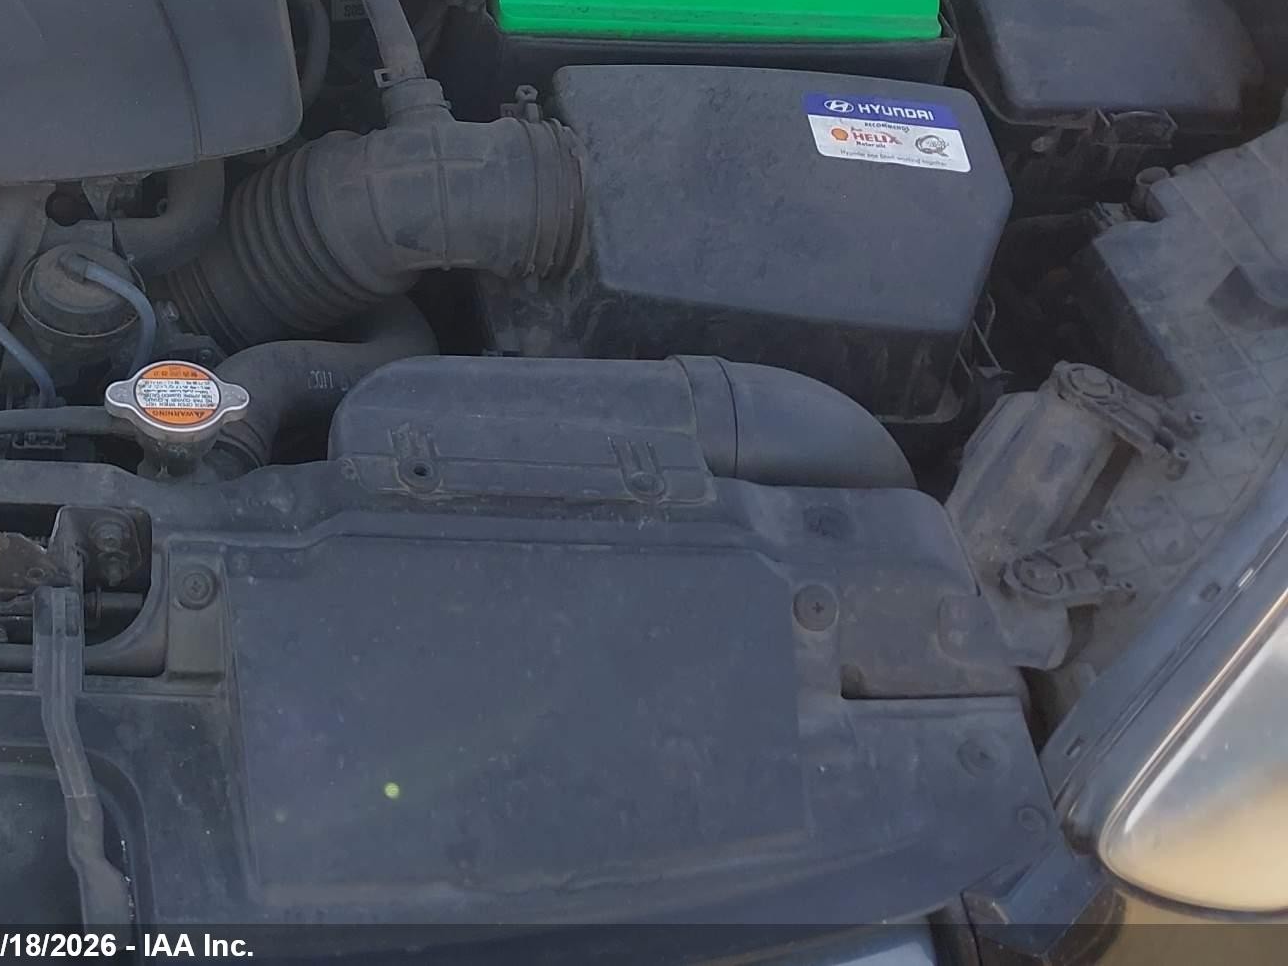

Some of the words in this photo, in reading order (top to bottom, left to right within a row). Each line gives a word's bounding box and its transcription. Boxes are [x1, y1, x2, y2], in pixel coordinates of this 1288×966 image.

[857, 103, 935, 121] HYUNDAI
[852, 132, 903, 145] HELIX
[151, 409, 195, 417] WARNING
